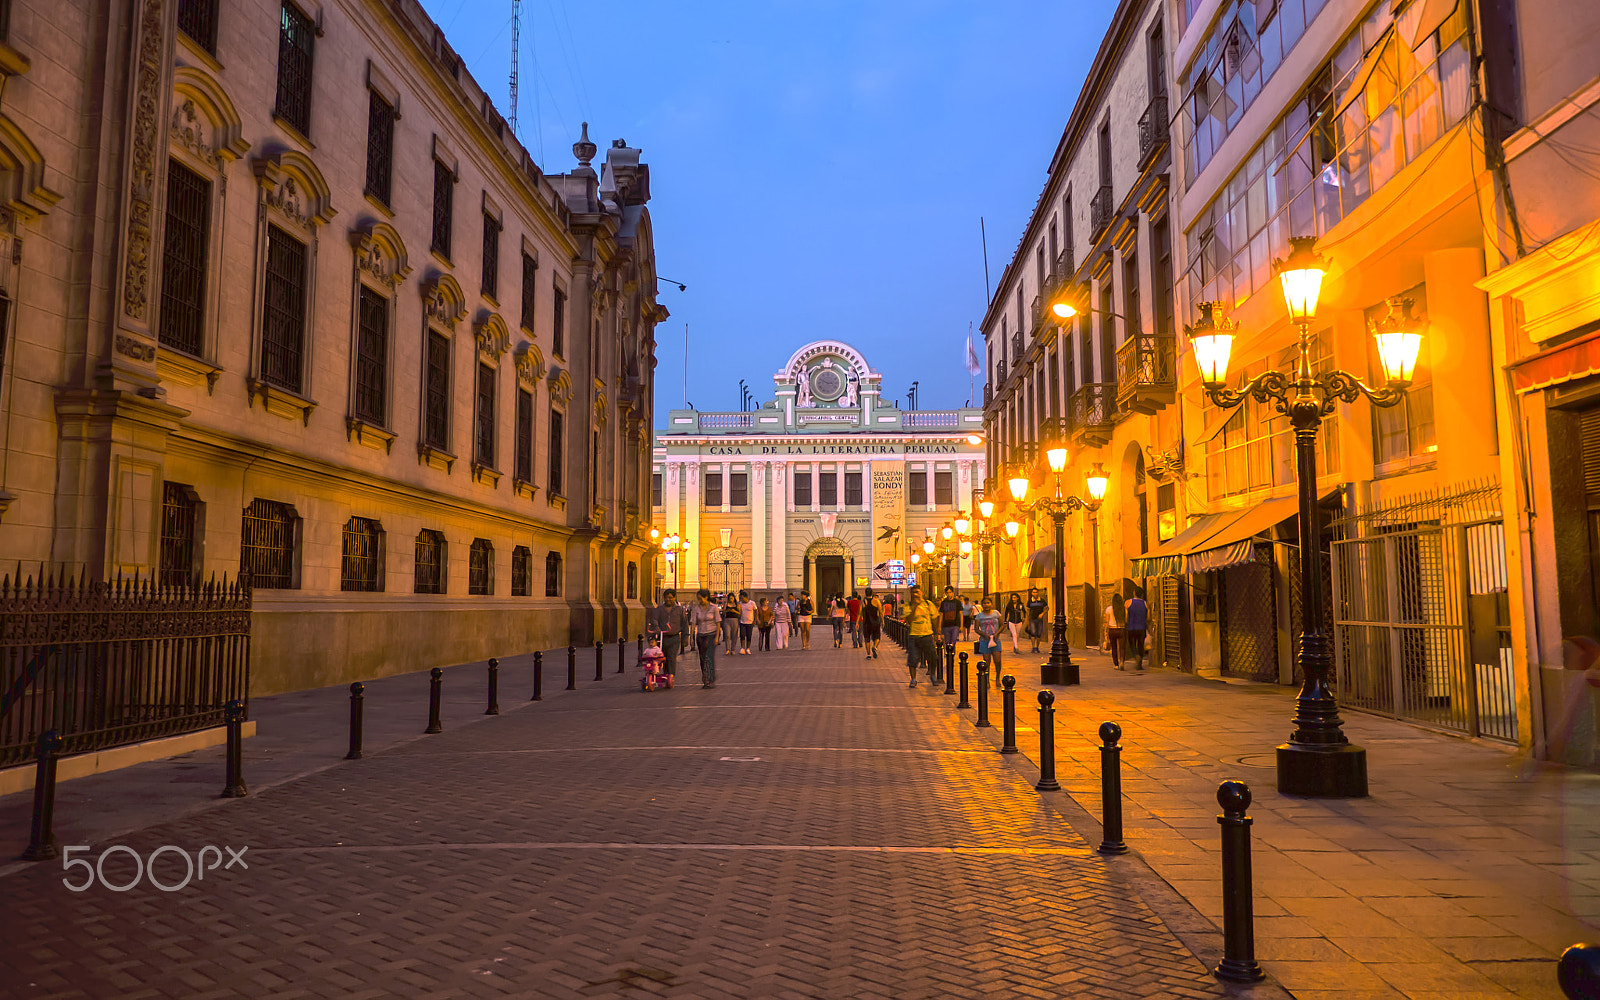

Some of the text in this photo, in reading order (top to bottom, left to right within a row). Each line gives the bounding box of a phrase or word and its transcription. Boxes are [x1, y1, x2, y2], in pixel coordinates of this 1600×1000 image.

[710, 445, 957, 455] CASA DE LA LITERATURA PERUANA
